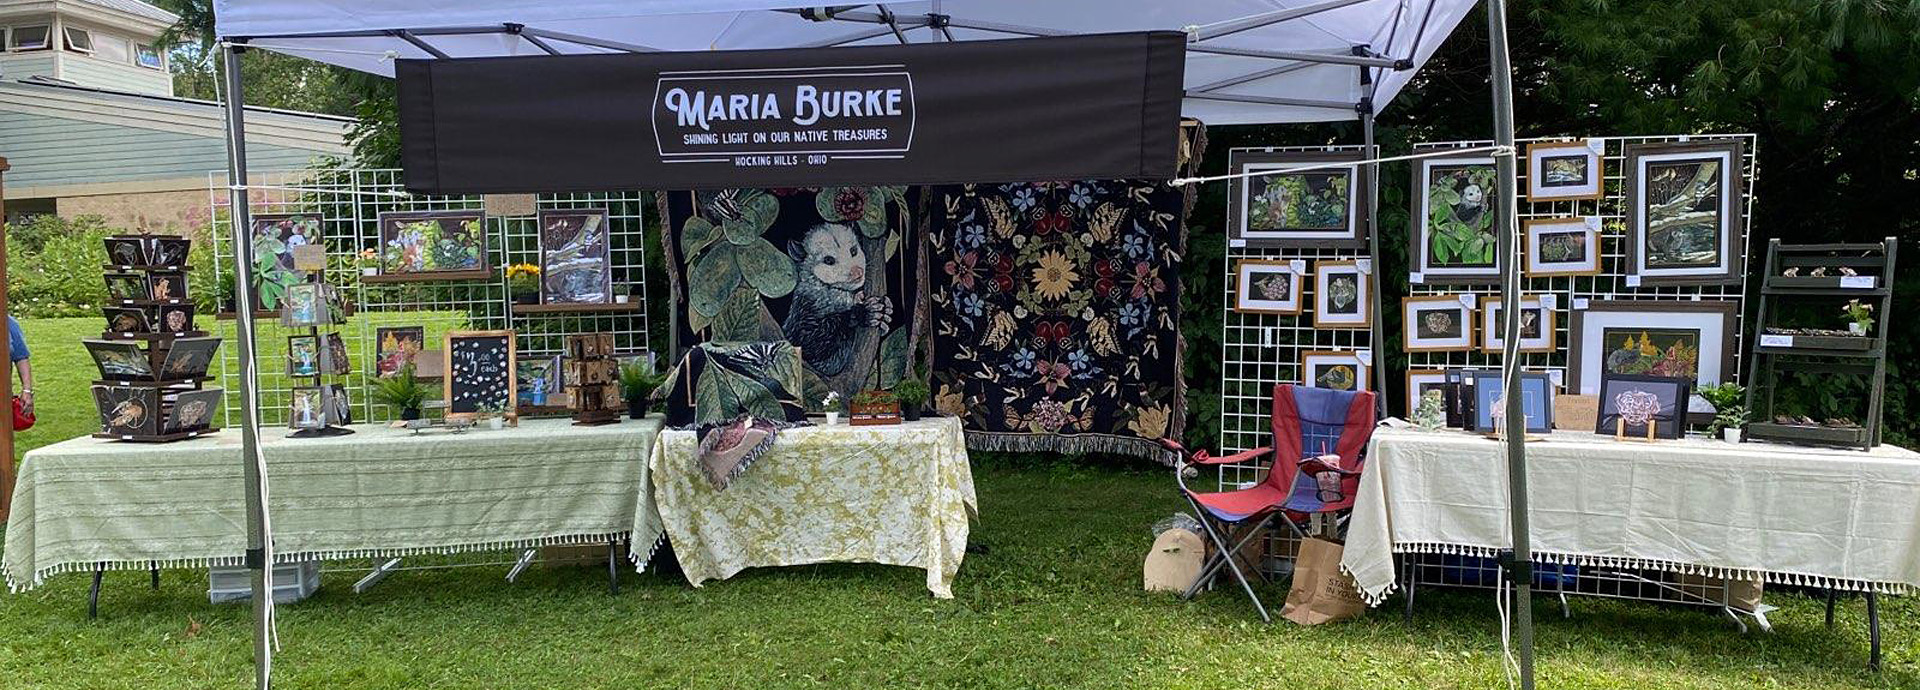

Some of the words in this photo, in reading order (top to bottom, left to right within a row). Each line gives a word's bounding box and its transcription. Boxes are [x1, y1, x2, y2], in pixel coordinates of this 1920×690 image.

[665, 87, 781, 131] MARIA
[792, 85, 902, 126] BURKE
[683, 133, 719, 145] SHINING
[723, 132, 748, 144] LIGHT
[753, 132, 767, 143] ON
[771, 131, 790, 143] OUR
[794, 130, 829, 142] NATIVE
[832, 129, 888, 141] TREASURES
[735, 156, 771, 167] HOCKING
[773, 156, 798, 166] HILLS
[808, 155, 828, 165] OHIO
[481, 364, 498, 373] each
[1326, 585, 1335, 595] IN
